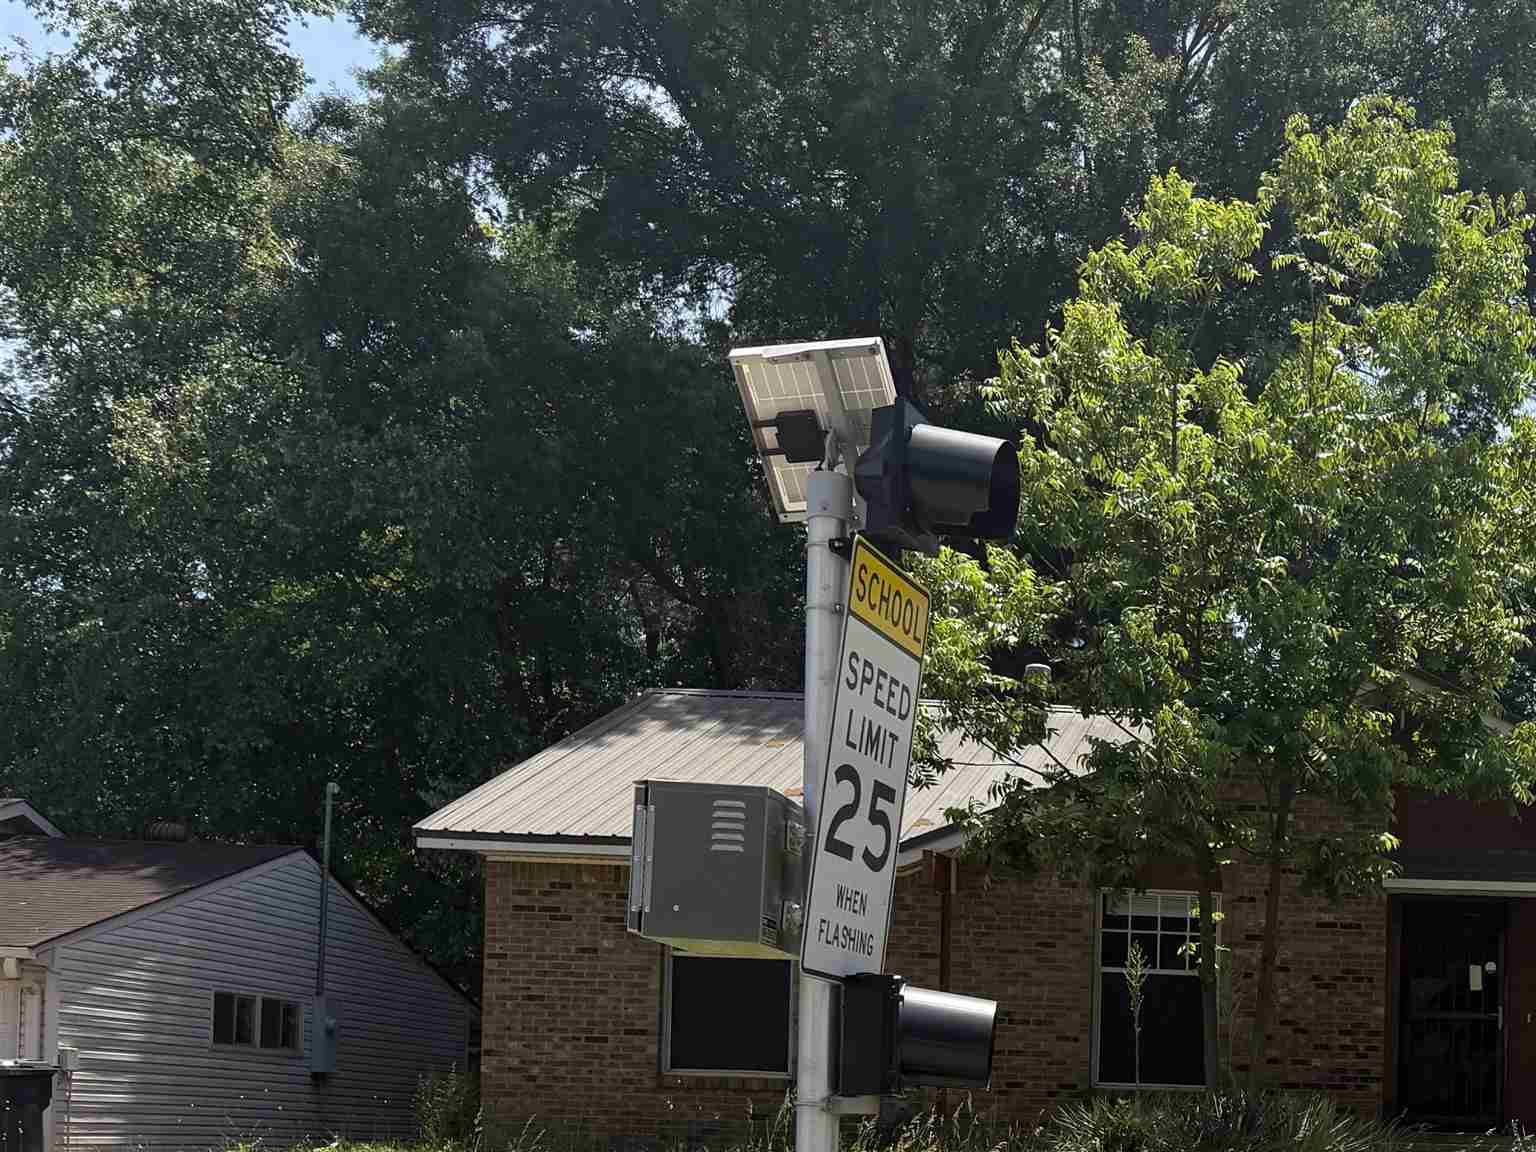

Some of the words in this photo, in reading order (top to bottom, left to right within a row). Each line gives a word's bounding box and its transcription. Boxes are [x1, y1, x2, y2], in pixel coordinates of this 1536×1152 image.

[855, 562, 923, 646] SCHOOL
[846, 651, 911, 721] SPEED
[846, 708, 899, 769] LIMIT
[824, 763, 897, 873] 25
[836, 882, 868, 917] WHEN
[818, 918, 874, 957] FLASHING
